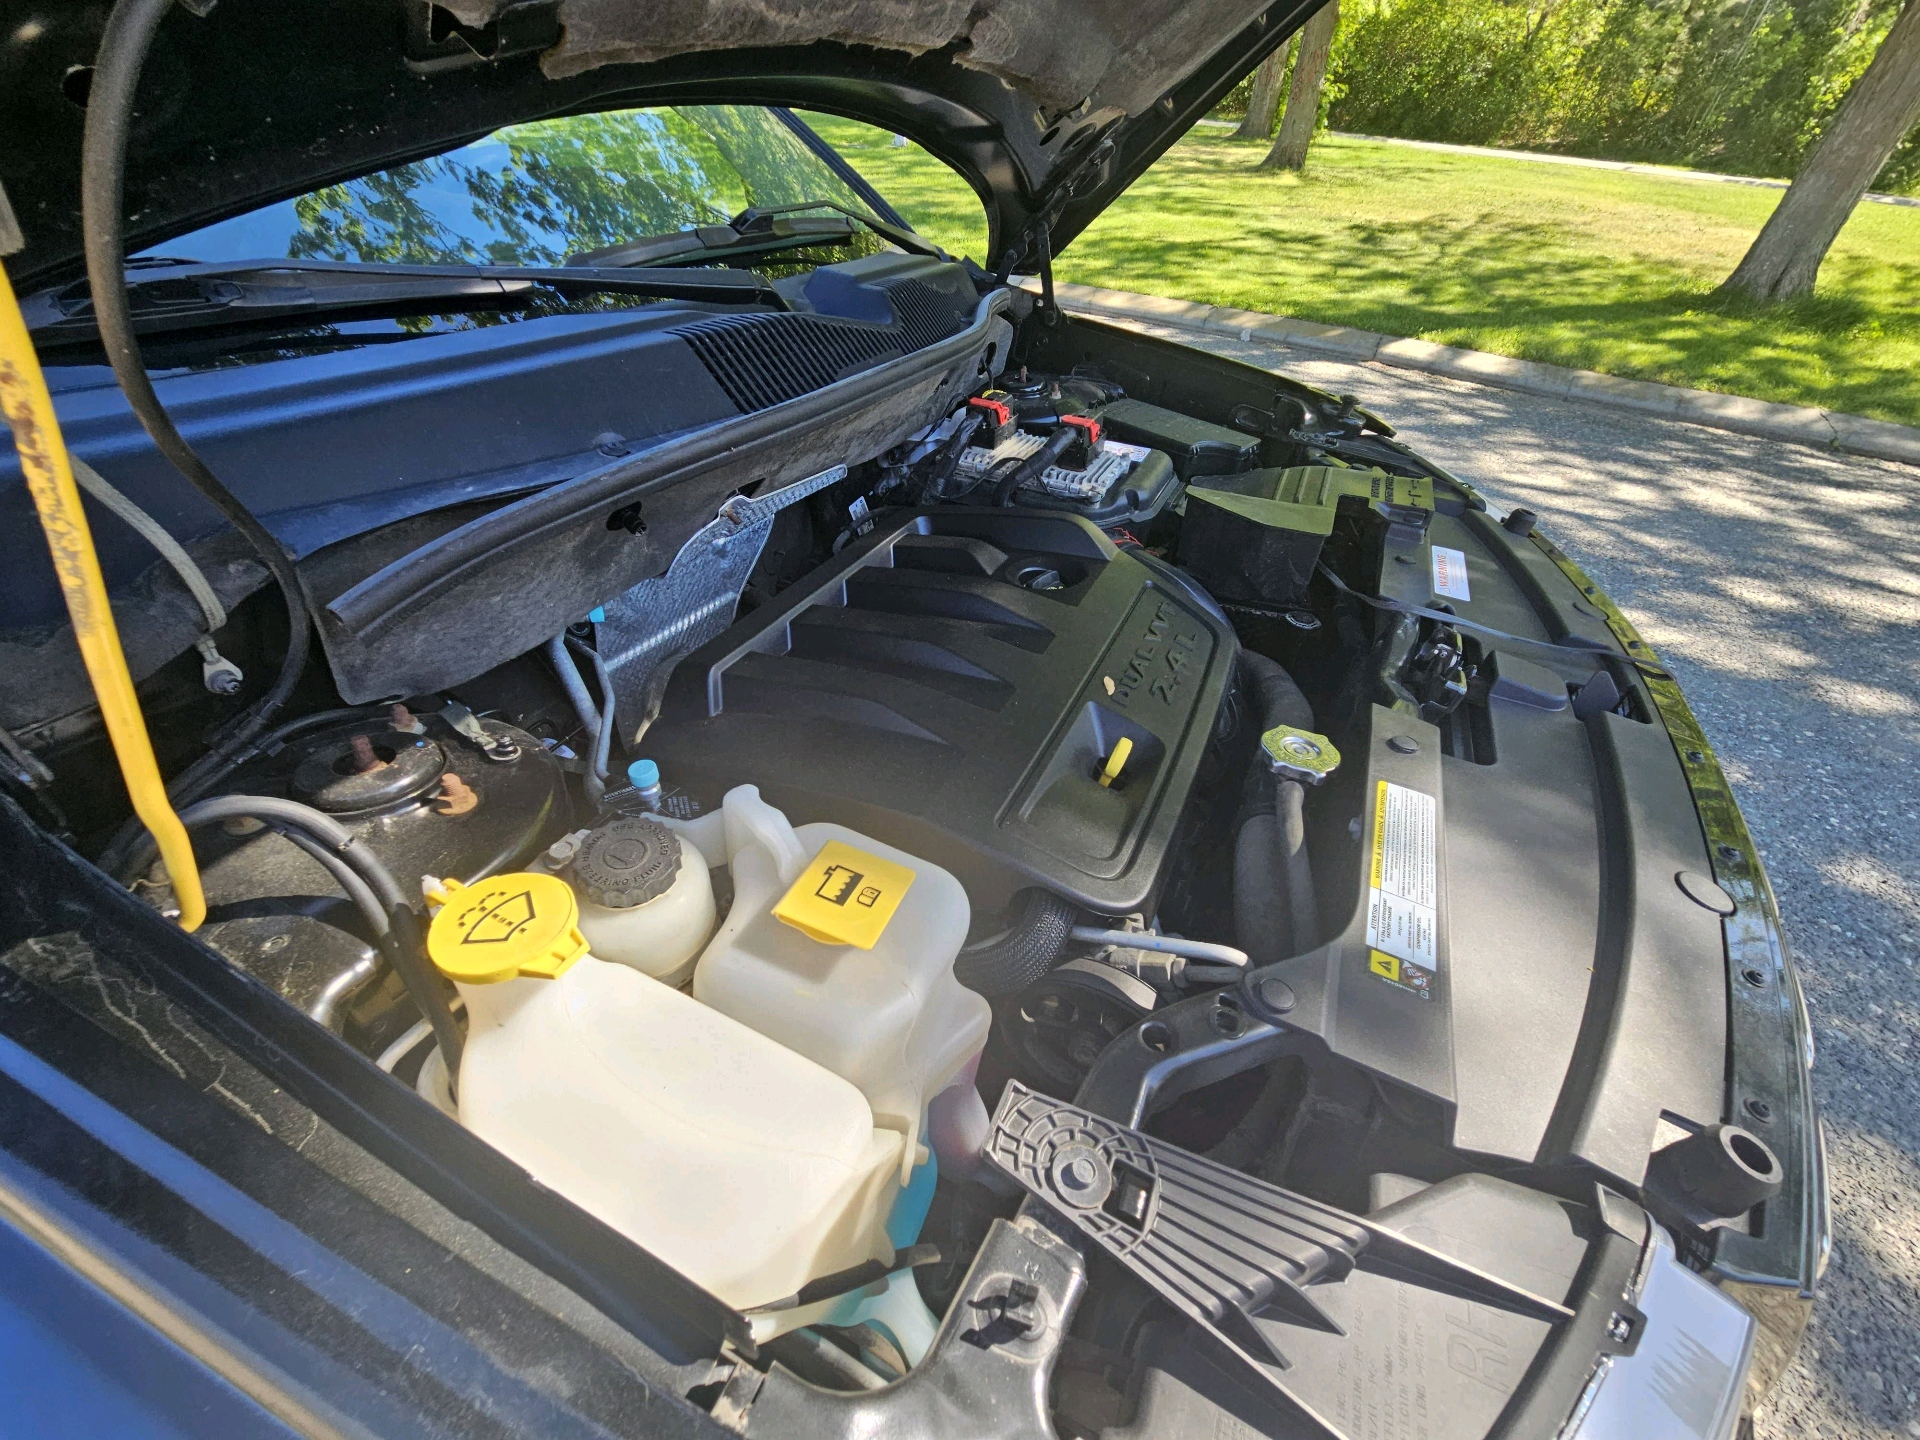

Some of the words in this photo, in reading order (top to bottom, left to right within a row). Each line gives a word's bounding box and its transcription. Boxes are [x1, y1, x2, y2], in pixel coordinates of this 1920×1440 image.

[1437, 554, 1448, 587] WARNING
[1110, 648, 1154, 707] DUAL
[1149, 634, 1196, 706] 2.4L
[582, 864, 629, 886] STEERING
[633, 861, 662, 882] FLUID
[1370, 903, 1378, 930] ATTENTION
[1445, 1301, 1512, 1396] RH
[1352, 1376, 1362, 1436] HOUSING
[1415, 1383, 1428, 1419] LENS
